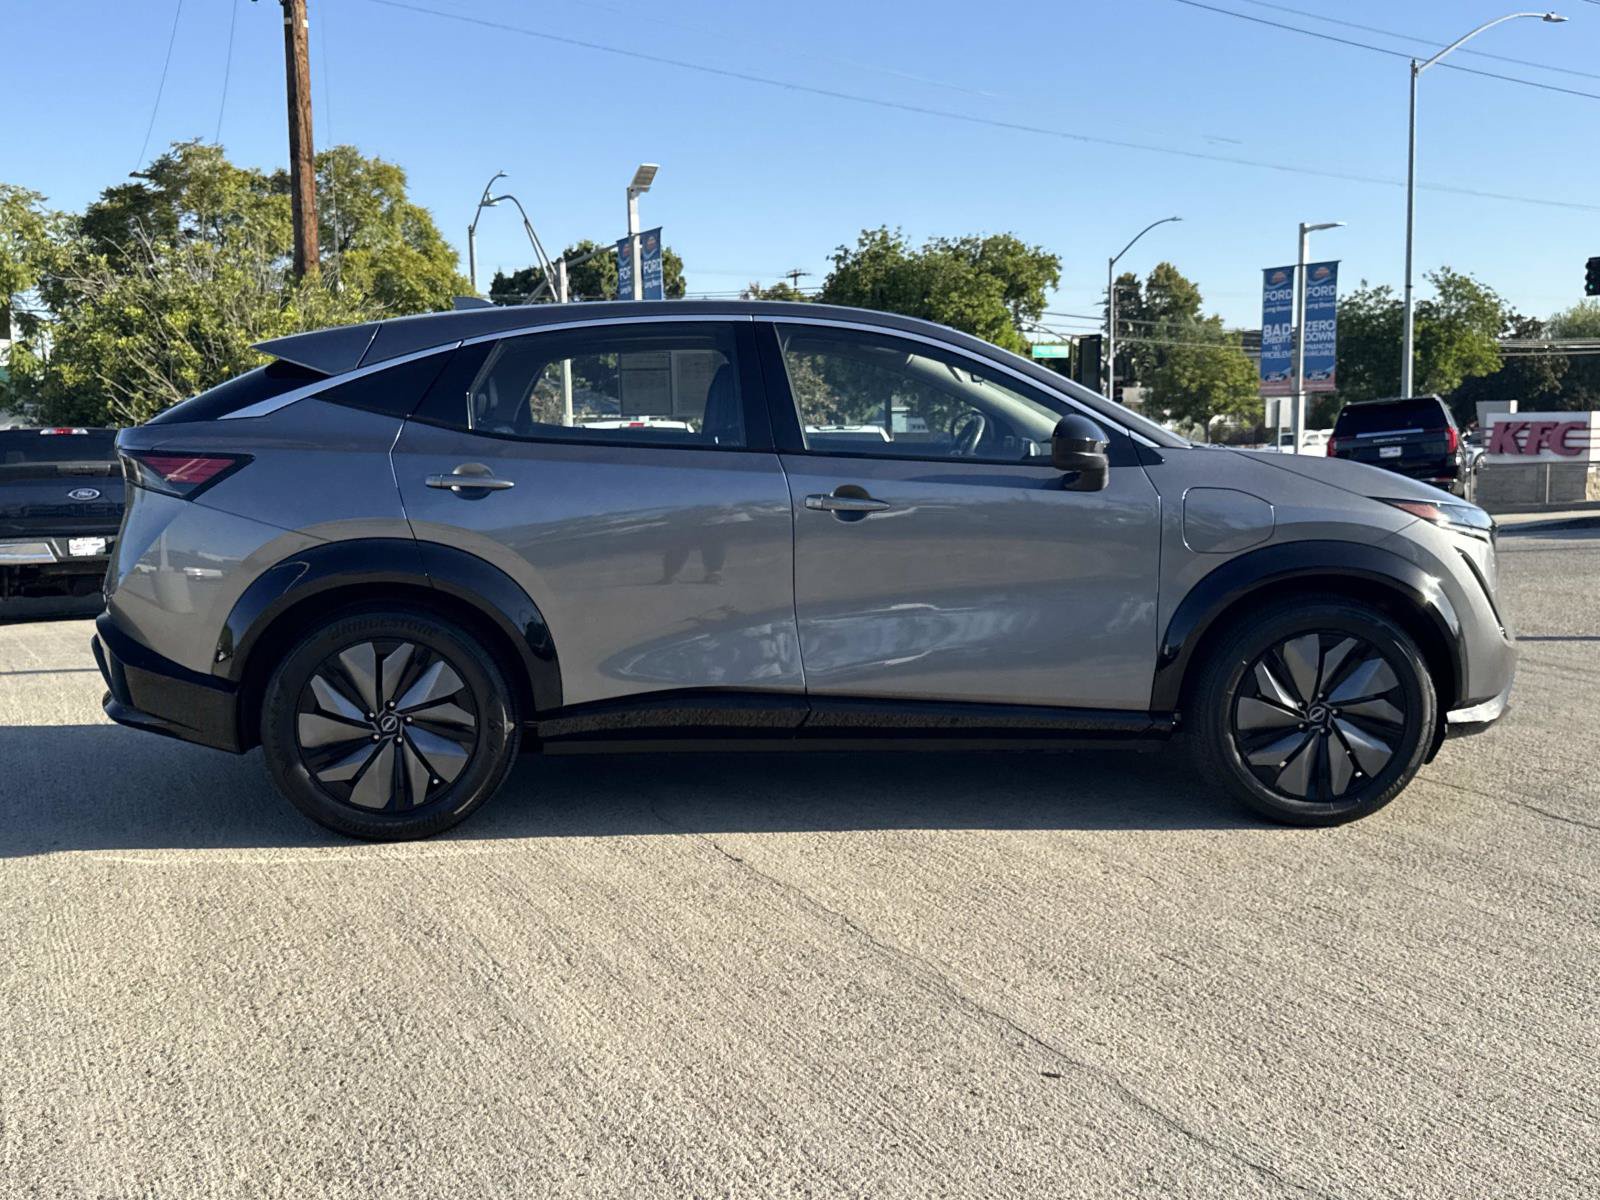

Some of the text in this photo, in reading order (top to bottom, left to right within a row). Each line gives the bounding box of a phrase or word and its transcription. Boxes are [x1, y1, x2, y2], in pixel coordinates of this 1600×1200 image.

[1263, 289, 1293, 302] FORD
[1306, 285, 1337, 298] FORD
[1263, 323, 1291, 338] BAD
[1305, 320, 1336, 332] ZERO
[1304, 331, 1336, 343] DOWN
[1487, 420, 1588, 457] KFC
